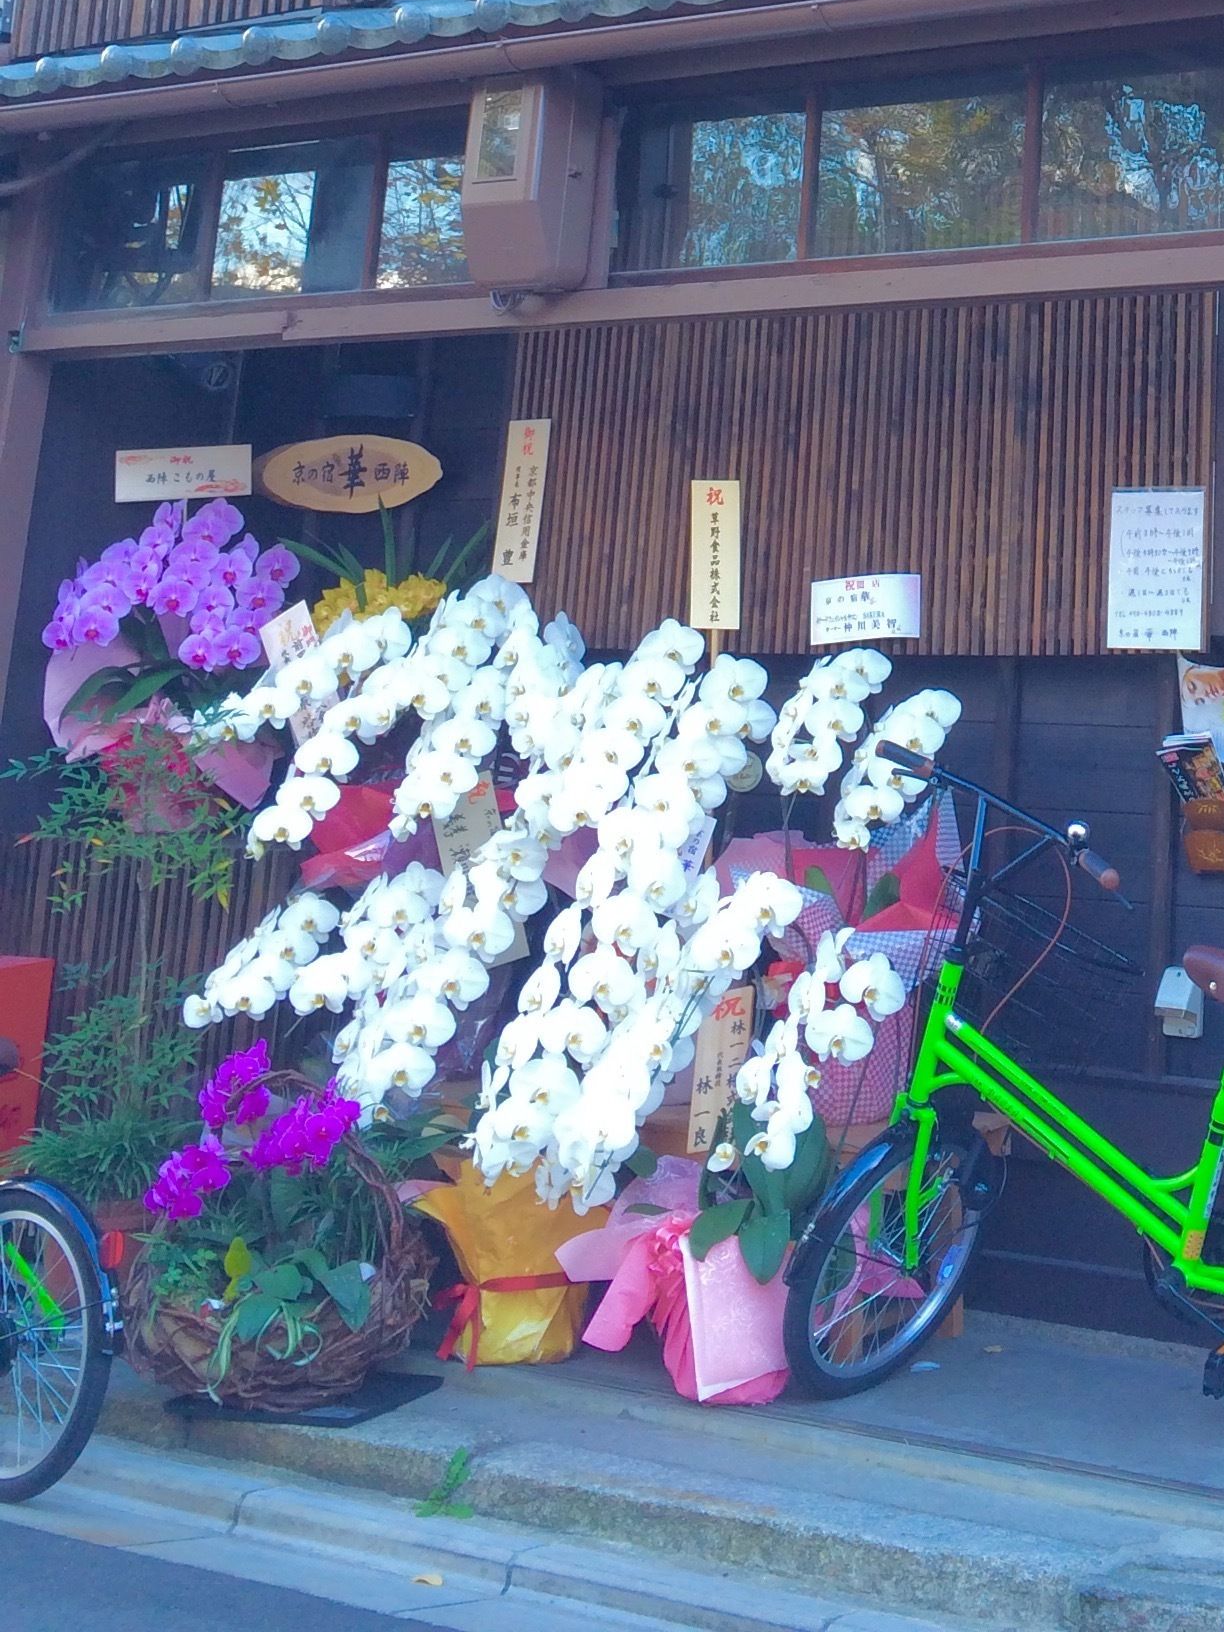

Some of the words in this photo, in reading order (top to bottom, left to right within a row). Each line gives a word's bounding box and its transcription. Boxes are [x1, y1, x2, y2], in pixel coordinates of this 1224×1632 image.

[292, 460, 335, 486] 京の宿
[338, 443, 367, 500] 華
[374, 462, 409, 487] 西陣
[706, 486, 725, 506] 祝
[518, 465, 539, 562] 京都中央信用金庫
[708, 512, 721, 623] 草野食品株式会社
[711, 996, 746, 1021] 祝
